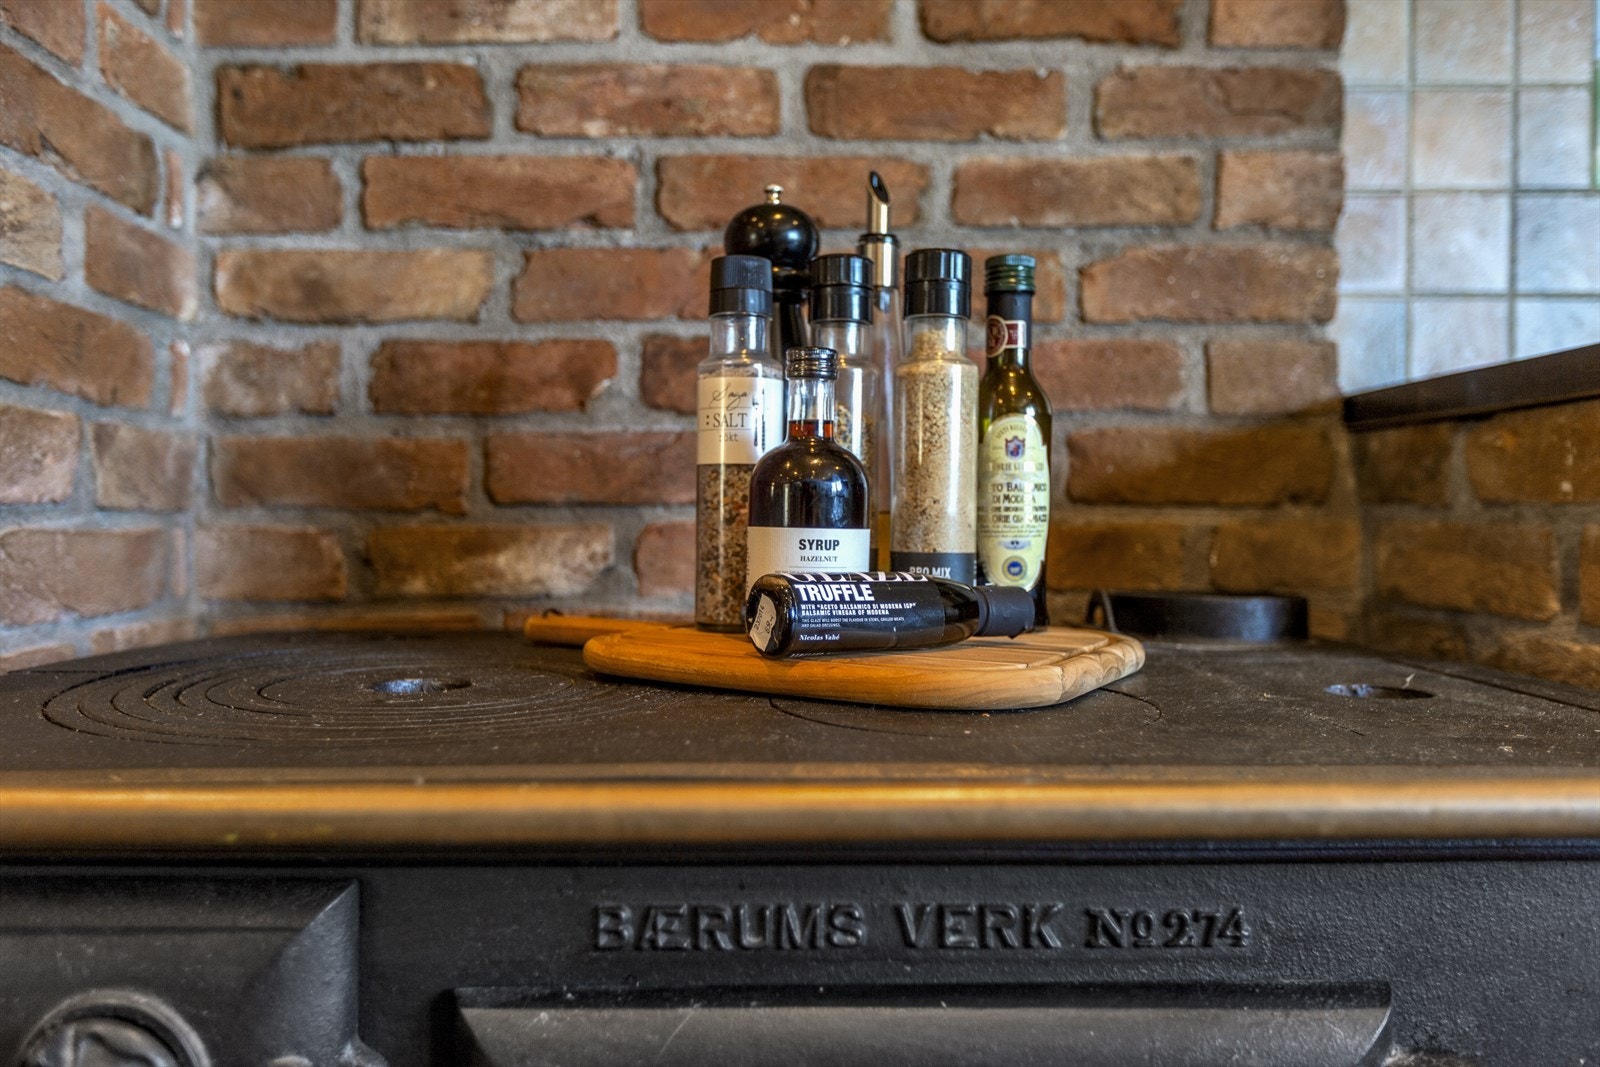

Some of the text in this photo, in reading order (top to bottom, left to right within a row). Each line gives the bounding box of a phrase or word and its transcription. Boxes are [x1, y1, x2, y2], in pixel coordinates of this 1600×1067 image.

[798, 538, 840, 551] SYRUP
[931, 566, 952, 579] MIX
[794, 583, 875, 601] TRUFFLE
[824, 633, 840, 641] Vahé
[596, 902, 867, 949] BÆRUMS
[896, 901, 1065, 949] VERK
